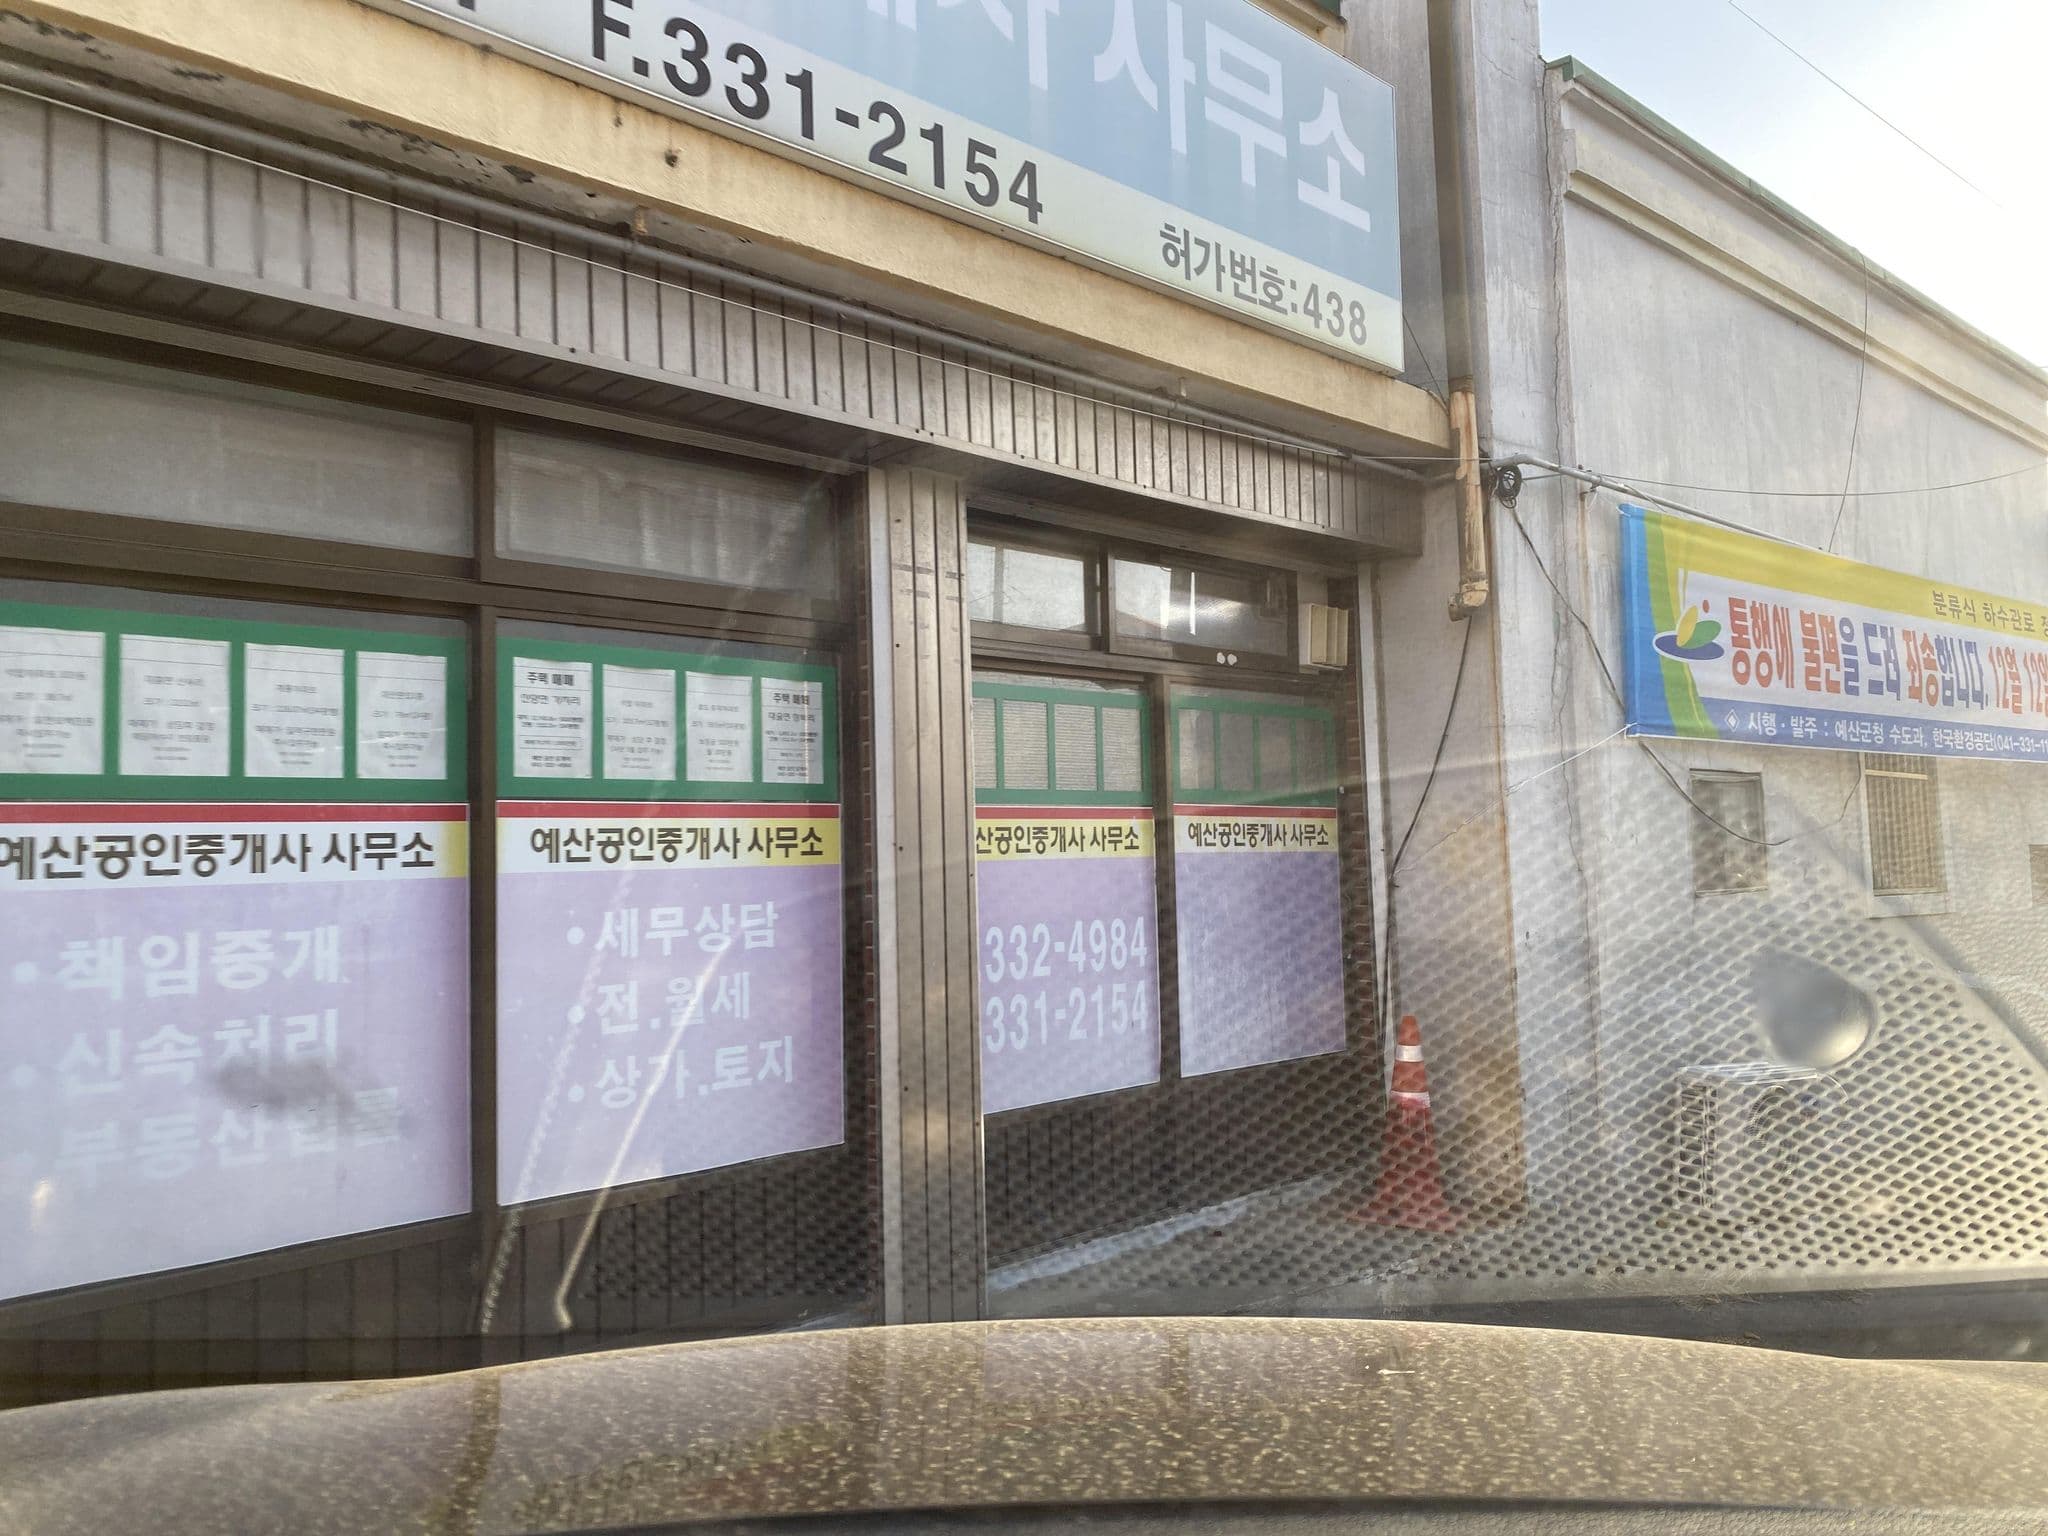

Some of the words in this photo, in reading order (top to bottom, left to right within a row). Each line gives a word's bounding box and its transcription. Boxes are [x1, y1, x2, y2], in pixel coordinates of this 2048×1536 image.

[592, 0, 1043, 225] F.331-2154
[1093, 0, 1371, 233] 사무소
[1159, 222, 1368, 347] 허가번호:438
[1982, 600, 2036, 633] 하수관로
[1728, 597, 1795, 689] 통행에
[1800, 609, 1860, 697] 불편을
[1862, 622, 1901, 701] 드려
[1902, 629, 1989, 711] 죄송합니다.
[1749, 711, 1777, 737] 시행
[1834, 719, 1884, 745] 예산군청
[0, 832, 312, 881] 예산공인중개사
[322, 831, 435, 872] 사무소
[530, 827, 740, 864] 예산공인중개사
[747, 826, 824, 858] 사무소
[1090, 825, 1141, 852] 사무소
[1187, 821, 1288, 849] 예산공인중개사
[1290, 823, 1330, 846] 사무소
[56, 925, 343, 1001] 책임중개
[595, 901, 779, 958] 세무상담
[985, 916, 1148, 983] 332-4984
[594, 971, 751, 1036] 전.월세
[985, 980, 1149, 1054] 331-2154
[57, 1008, 339, 1096] 신속처리
[594, 1035, 794, 1110] 상가.토지
